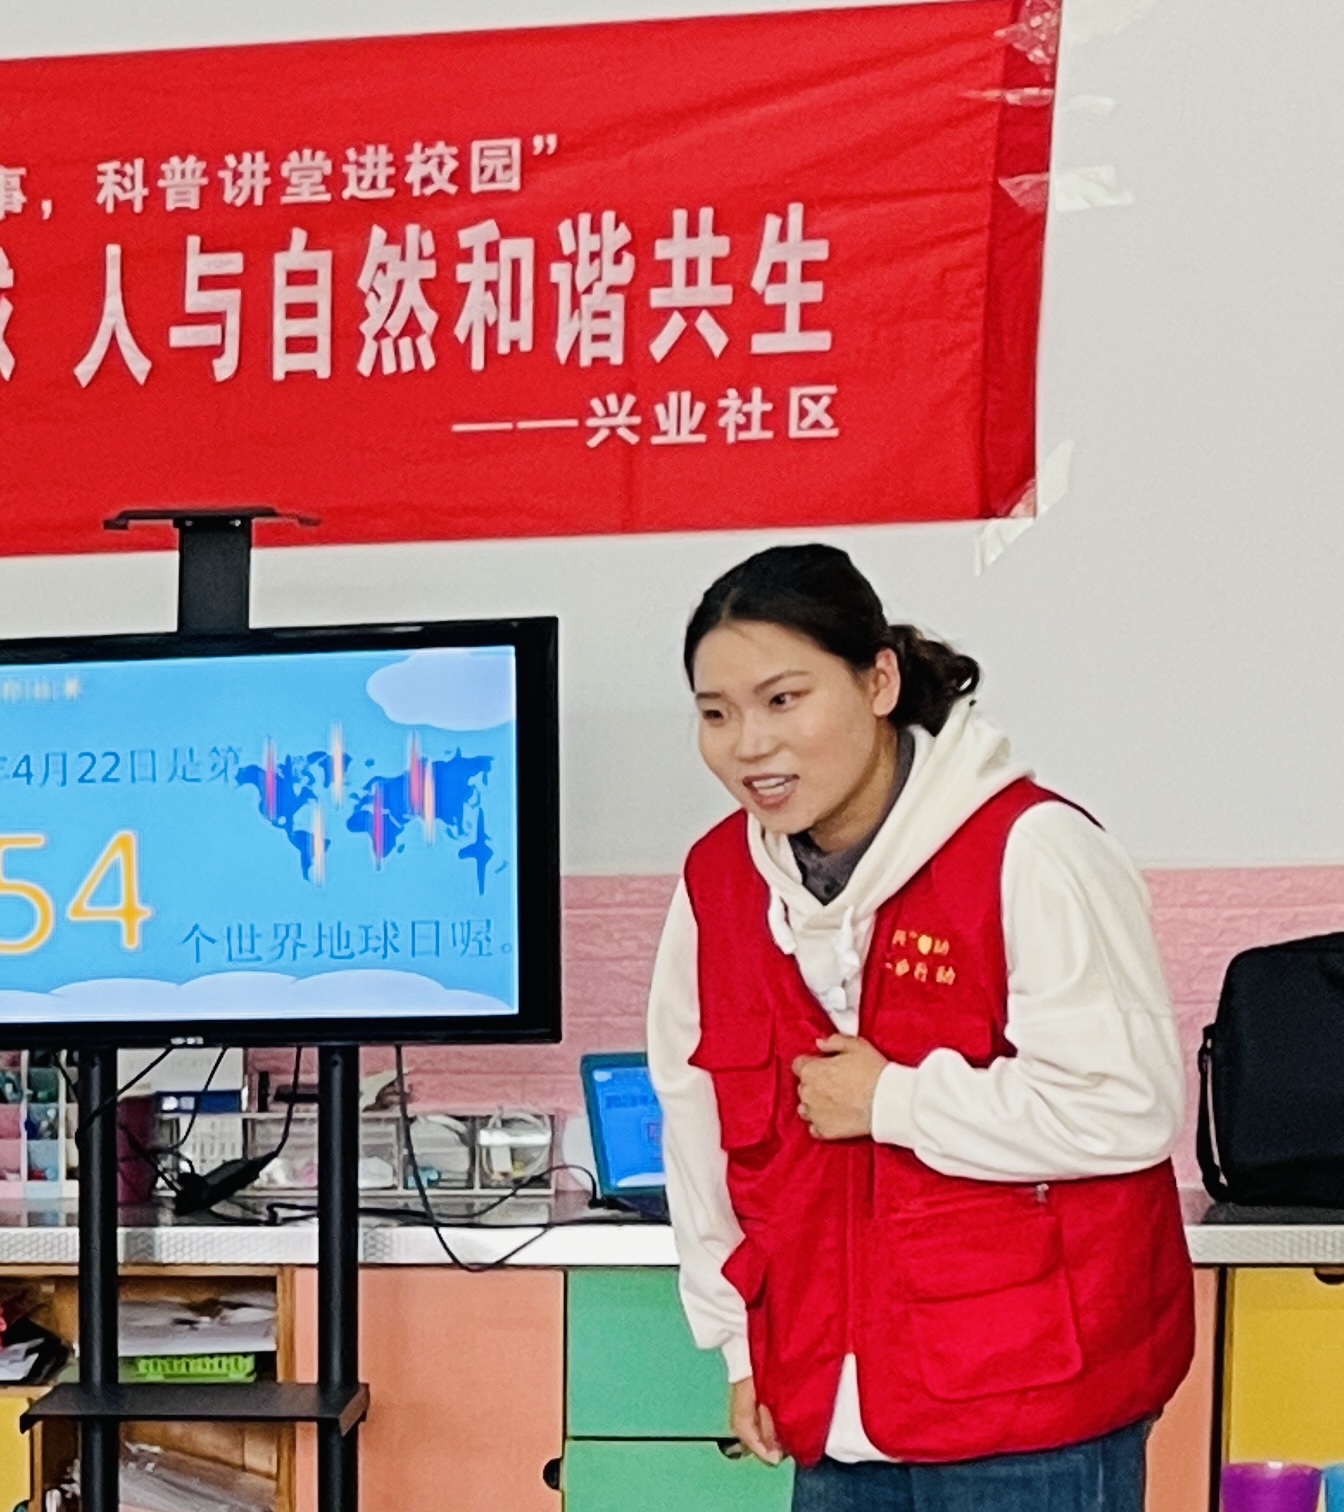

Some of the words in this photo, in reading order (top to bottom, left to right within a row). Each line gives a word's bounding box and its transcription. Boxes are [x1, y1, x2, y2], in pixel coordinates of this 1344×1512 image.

[72, 201, 833, 390] 人与自然和谐共生
